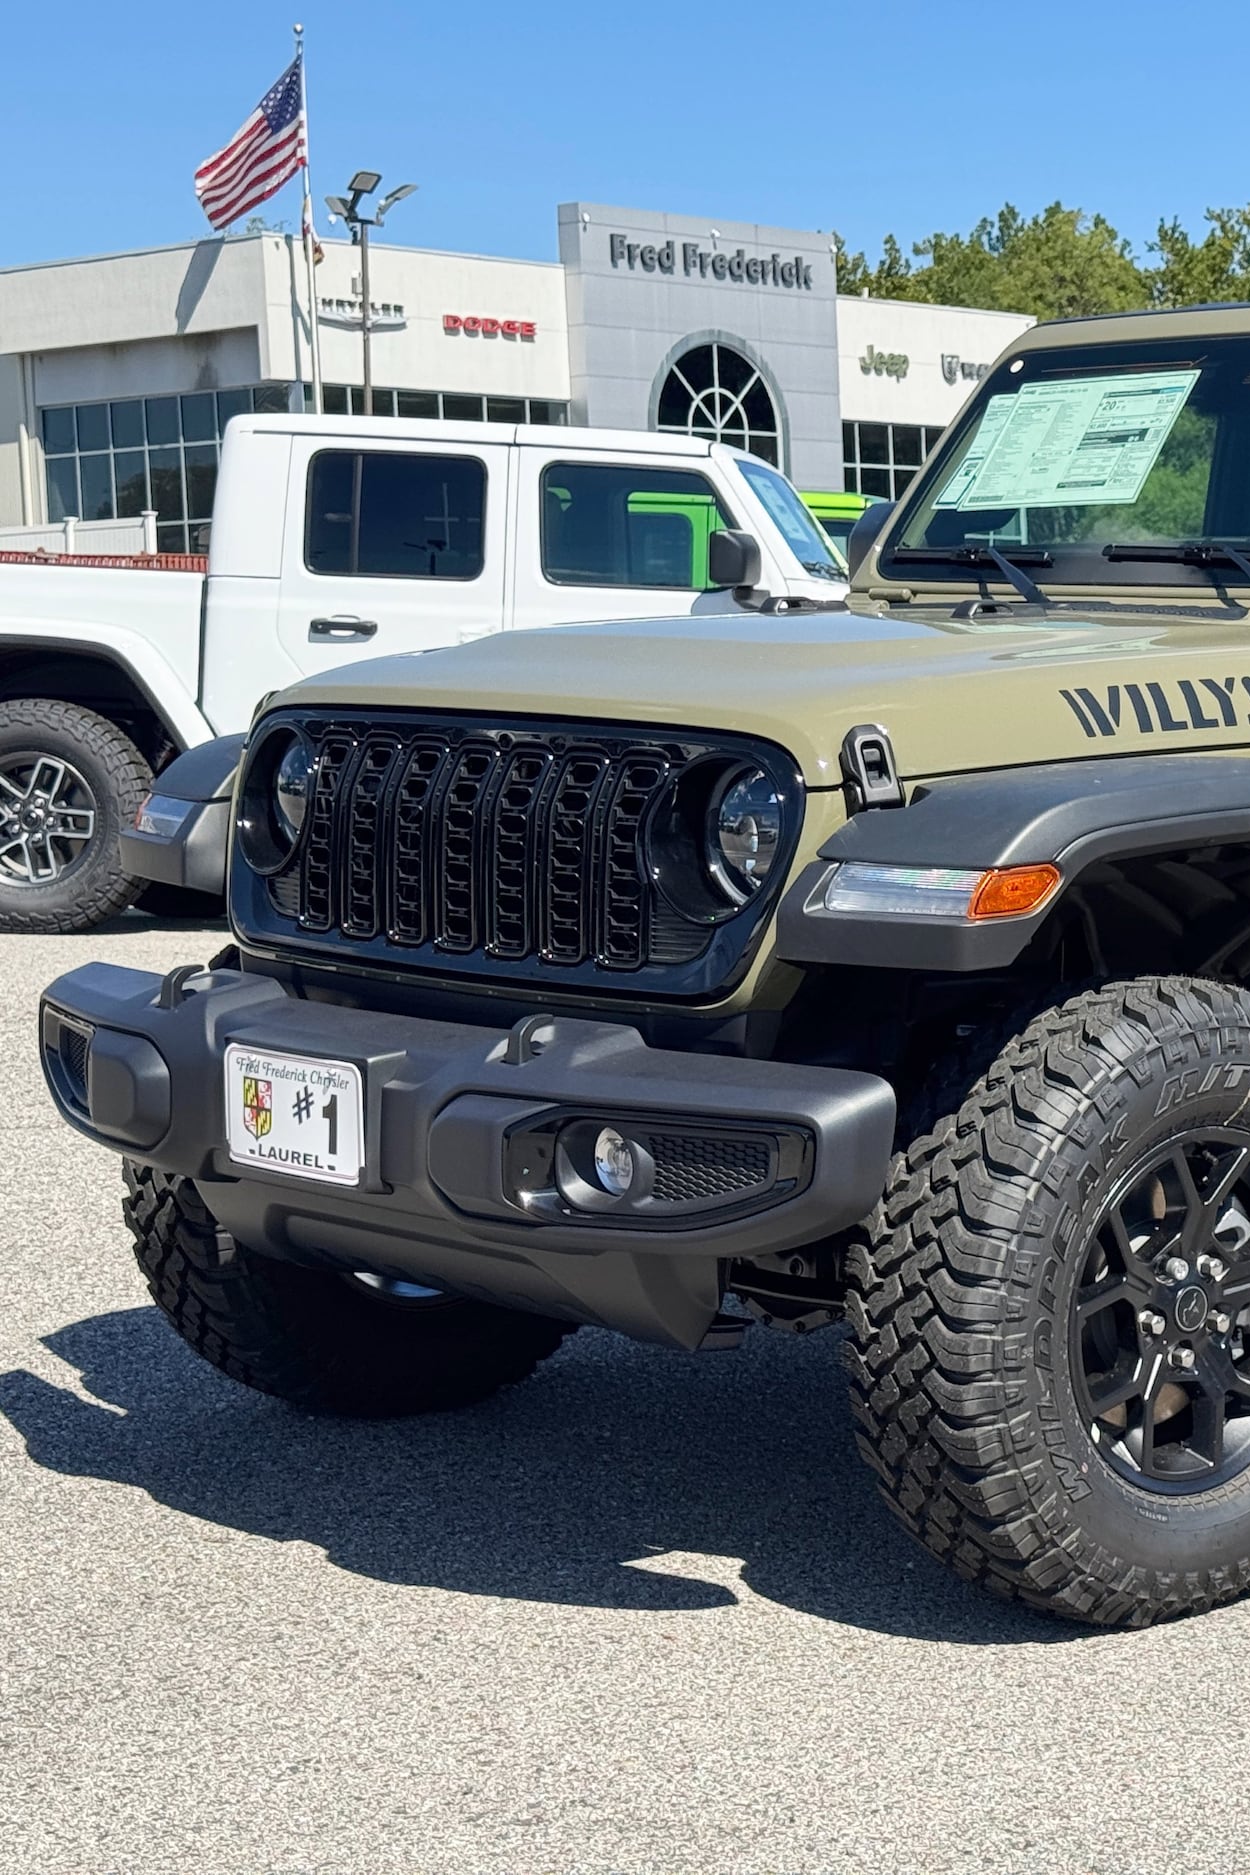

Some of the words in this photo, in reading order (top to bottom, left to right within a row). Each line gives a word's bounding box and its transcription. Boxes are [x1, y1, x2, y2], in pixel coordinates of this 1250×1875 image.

[610, 235, 675, 274] Fred
[682, 243, 813, 289] Frederick
[316, 297, 404, 313] HRYLER
[443, 314, 536, 339] DODGE
[859, 344, 909, 383] Jeep
[1102, 400, 1117, 411] 20
[236, 1056, 260, 1074] Fred
[262, 1062, 307, 1083] Frederick
[310, 1070, 350, 1091] Chrysler
[258, 1143, 324, 1169] LAUREL
[1033, 1112, 1130, 1503] WILDPEAK
